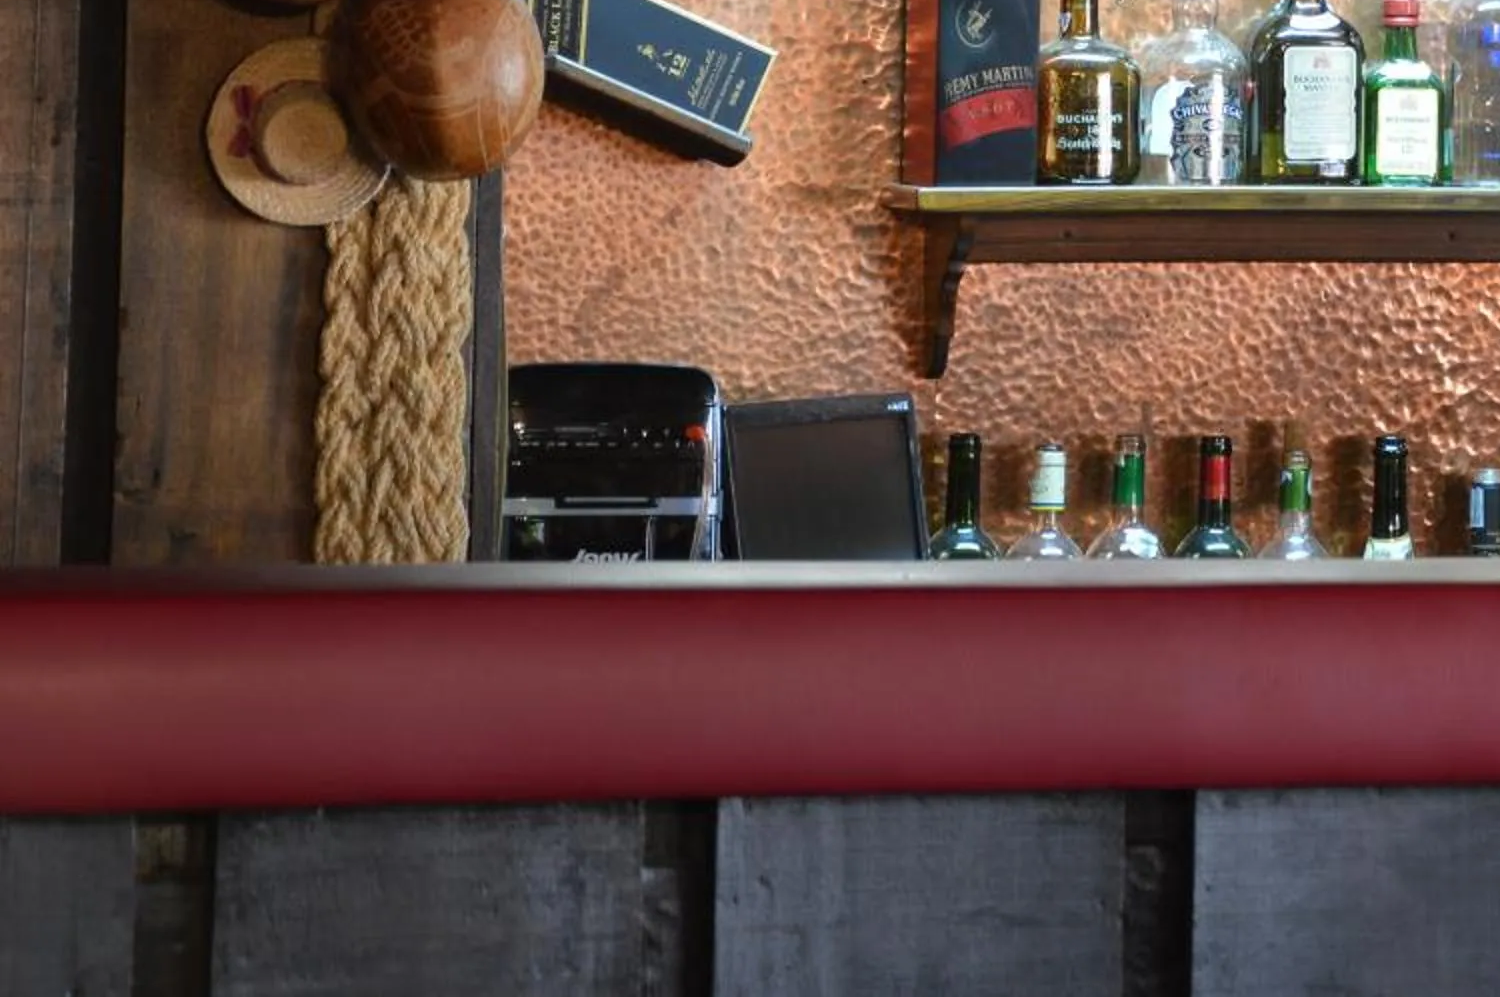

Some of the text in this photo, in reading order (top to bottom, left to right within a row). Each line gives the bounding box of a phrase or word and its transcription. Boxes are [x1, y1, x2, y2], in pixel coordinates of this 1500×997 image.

[547, 12, 560, 55] BLACK
[1056, 113, 1124, 124] BUCHAN'S
[1173, 103, 1216, 120] CHIVA
